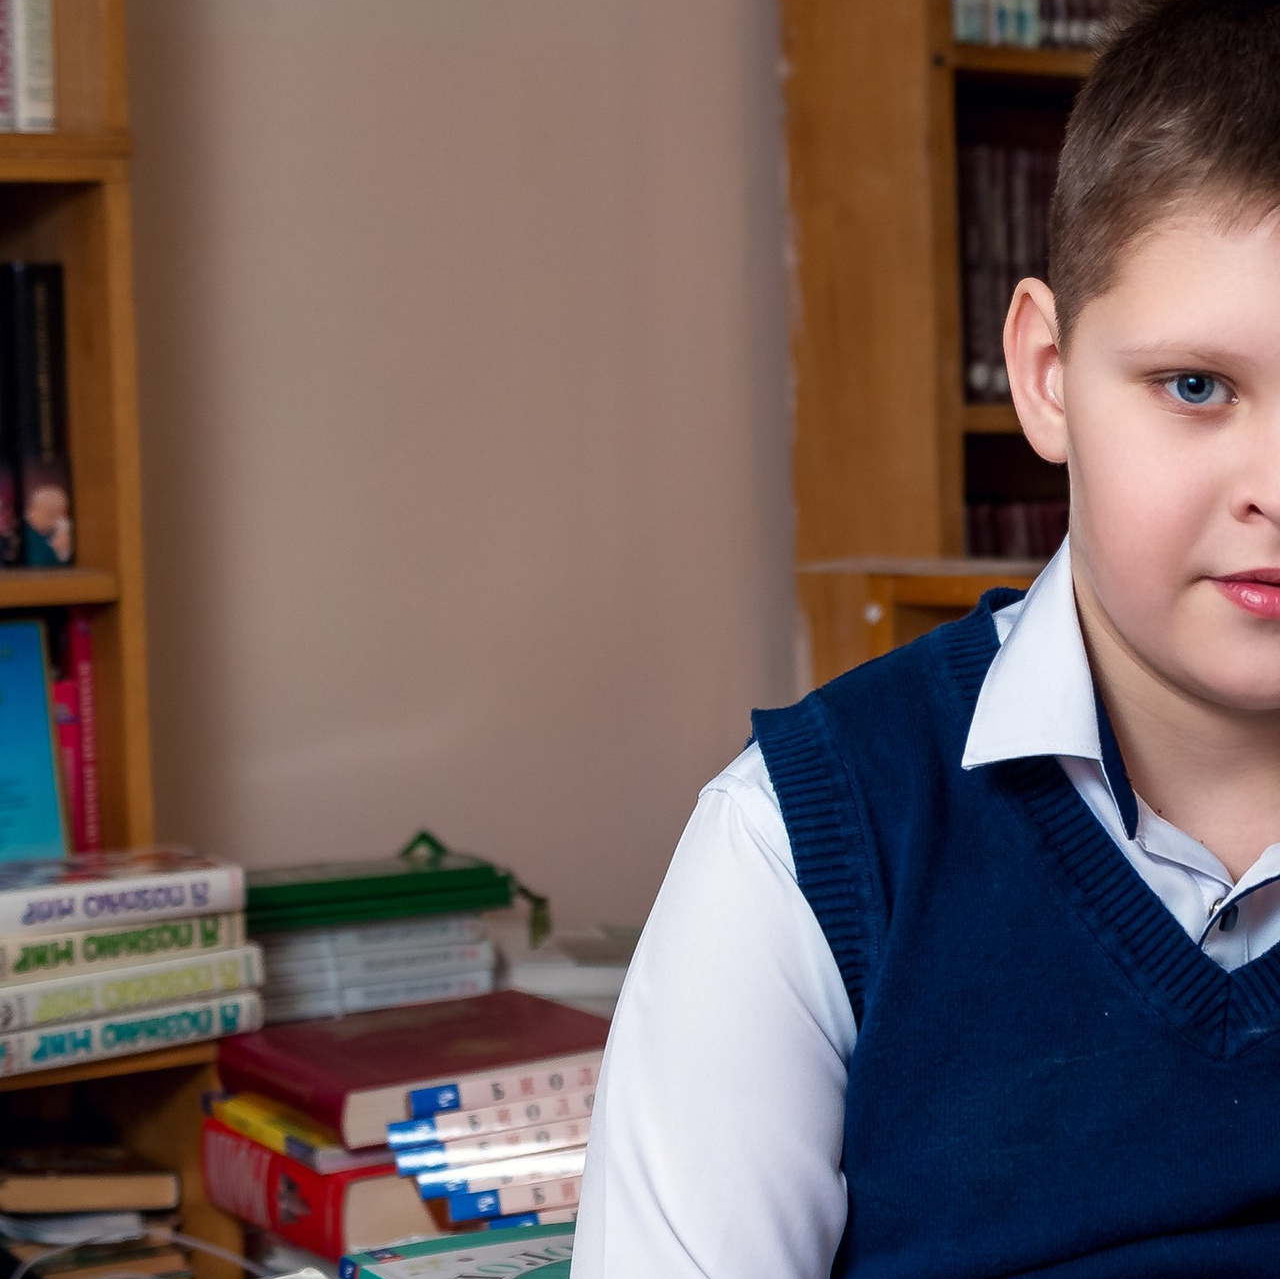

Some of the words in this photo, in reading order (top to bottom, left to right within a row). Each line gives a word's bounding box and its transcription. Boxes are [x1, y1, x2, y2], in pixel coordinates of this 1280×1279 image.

[21, 896, 76, 925] МИР
[82, 885, 187, 918] ПОЗНАЮ
[13, 938, 74, 973] МИР
[82, 922, 194, 962] ПОЗНАЮ
[31, 1026, 94, 1063] МИР
[101, 1007, 214, 1049] ПОЗНАЮ
